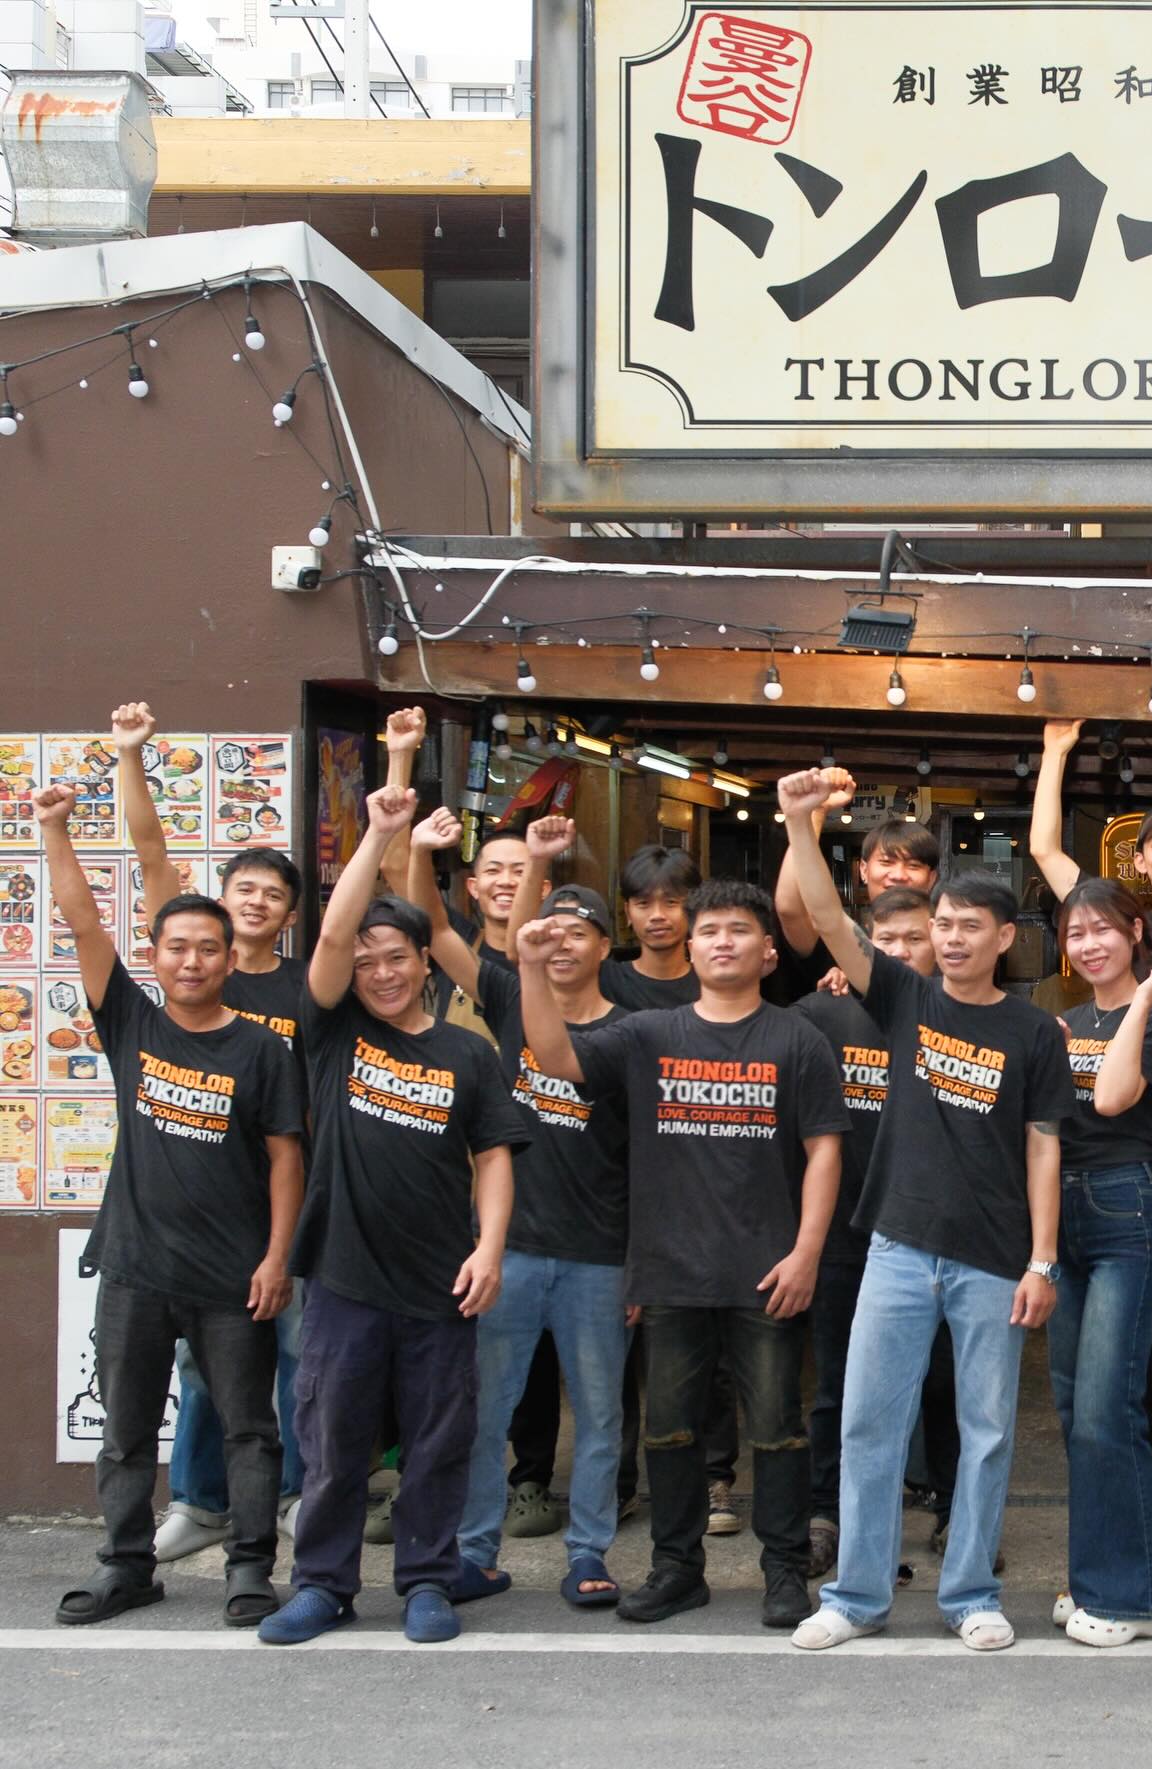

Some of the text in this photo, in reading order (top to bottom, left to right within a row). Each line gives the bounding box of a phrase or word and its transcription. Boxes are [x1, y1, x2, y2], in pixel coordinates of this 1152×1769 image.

[658, 1056, 777, 1084] THONGLOR
[657, 1078, 777, 1108] YOKOCHO
[971, 1089, 997, 1105] AND
[151, 1104, 229, 1131] COURAGE AND
[368, 1092, 424, 1118] COURAGE
[423, 1109, 449, 1123] AND
[690, 1109, 751, 1124] COURAGE
[752, 1112, 777, 1126] AND
[164, 1120, 227, 1144] EMPATHY
[382, 1108, 448, 1136] EMPATHY
[657, 1120, 777, 1140] HUMAN EMPATHY
